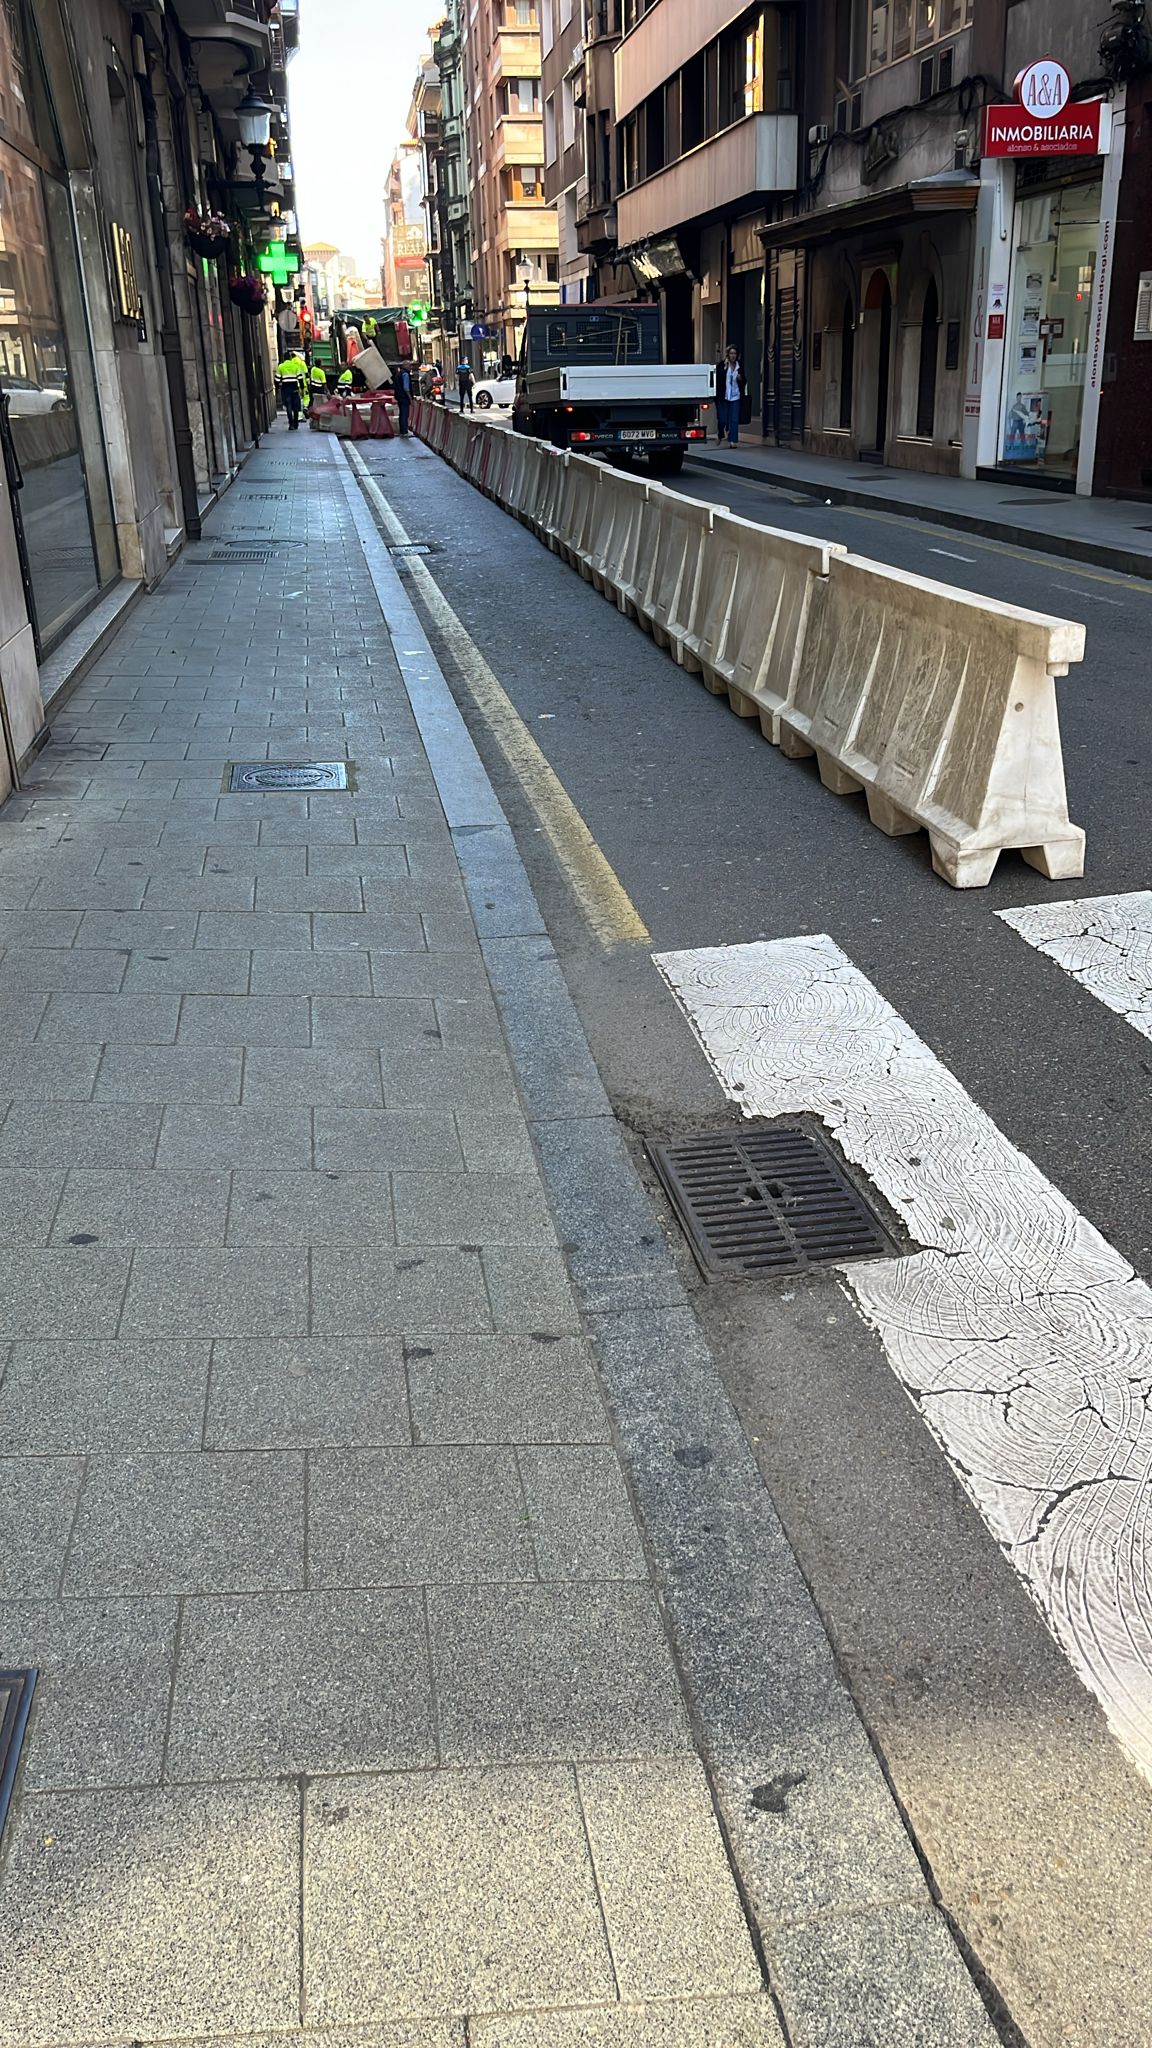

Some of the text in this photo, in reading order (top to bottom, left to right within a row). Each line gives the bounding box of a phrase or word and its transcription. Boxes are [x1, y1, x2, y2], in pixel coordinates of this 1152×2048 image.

[1027, 73, 1063, 106] A&A
[991, 125, 1093, 142] INMOBILIARIA
[1007, 142, 1077, 152] alonso & asociados
